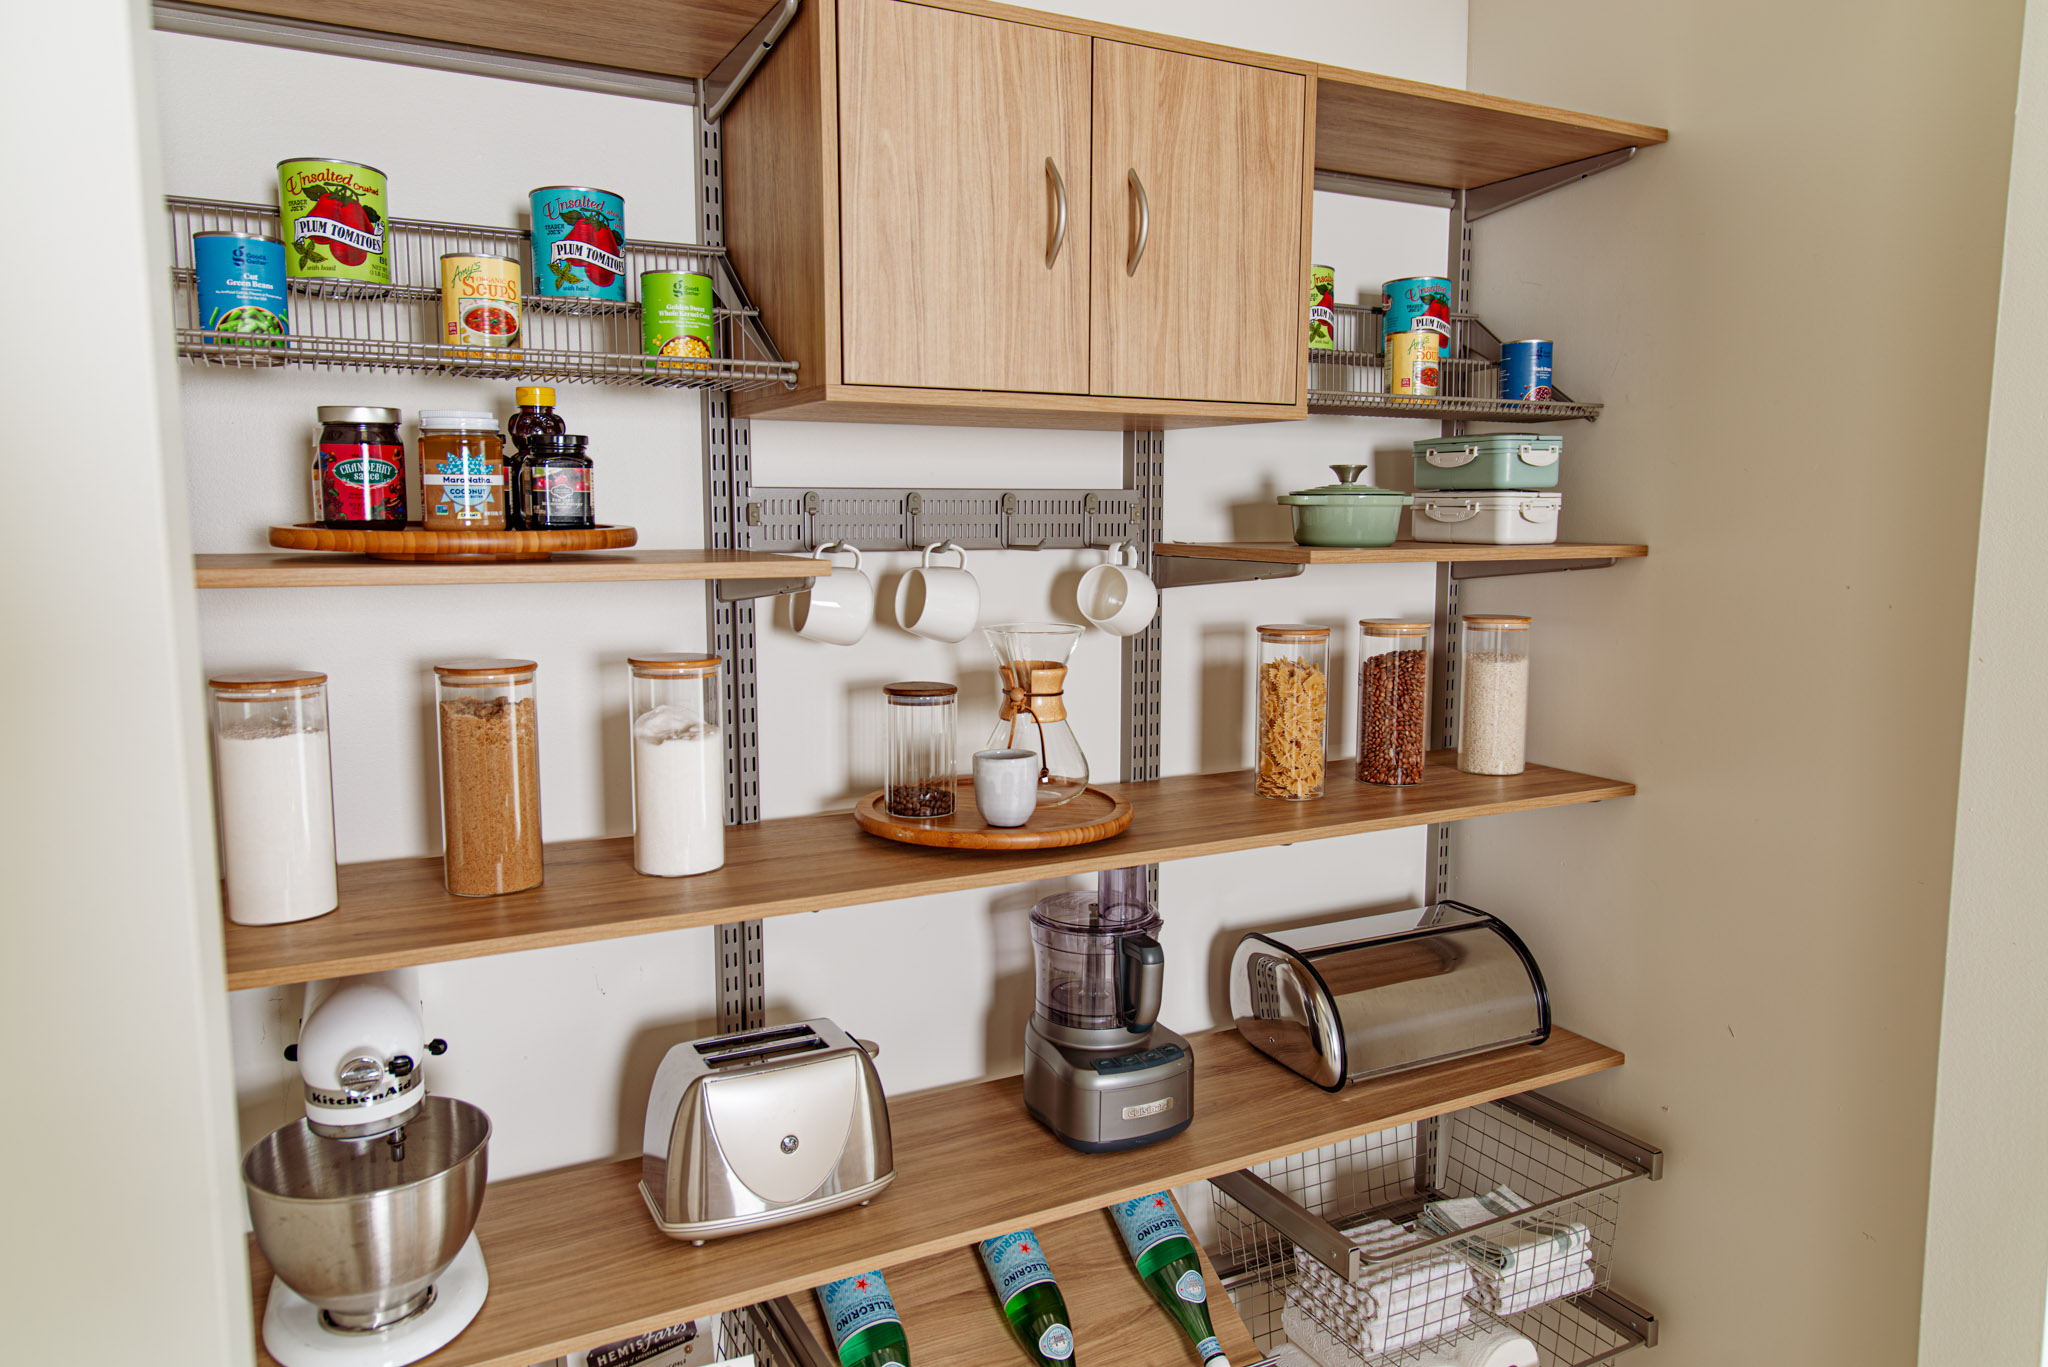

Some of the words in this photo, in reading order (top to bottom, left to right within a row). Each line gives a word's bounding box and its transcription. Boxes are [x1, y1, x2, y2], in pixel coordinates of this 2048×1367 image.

[286, 168, 353, 195] Unsalted
[542, 195, 605, 220] Unsalted
[299, 220, 328, 233] PLUM
[330, 224, 382, 252] TOMATOES
[556, 243, 583, 256] PLUM
[586, 247, 625, 273] TOMATOES
[226, 279, 251, 287] Green
[252, 281, 273, 289] Beans
[462, 276, 517, 300] SOUPS
[1405, 283, 1447, 302] Unsalted
[1416, 318, 1435, 327] PLUM
[339, 462, 392, 475] CRANERRY
[354, 472, 379, 480] sace
[312, 1079, 412, 1106] KitchenAid
